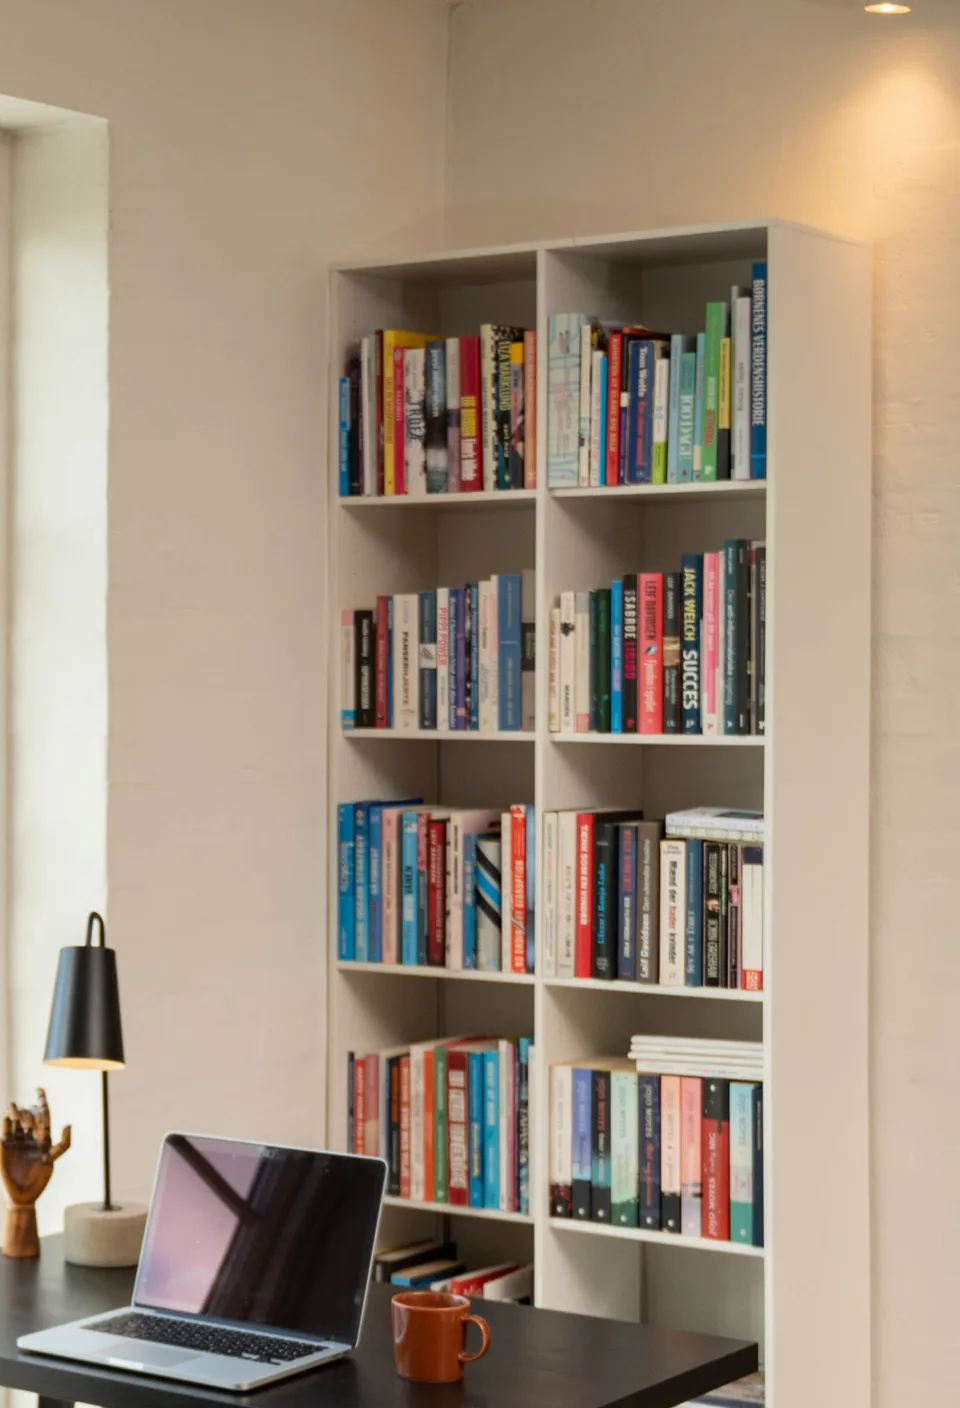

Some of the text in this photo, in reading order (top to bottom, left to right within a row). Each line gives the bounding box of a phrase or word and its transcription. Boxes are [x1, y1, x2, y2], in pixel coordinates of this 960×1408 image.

[499, 341, 511, 360] LIZA
[638, 347, 648, 398] Tom Wolfe
[752, 279, 764, 426] BØRNENES VERDENSHISTORIE
[499, 361, 511, 411] MARKLUND
[679, 394, 692, 461] 100 DAGE
[439, 607, 448, 631] PIPPI
[645, 581, 657, 640] LEIF DAVIDSEN
[683, 567, 695, 641] JACK WELCH
[624, 596, 635, 680] SABROE LIBIDO
[682, 651, 697, 710] SUCCES
[580, 853, 588, 874] SOM
[580, 875, 588, 889] EN
[580, 890, 588, 925] VINDER
[669, 861, 678, 964] Mænd der hader kvinder
[640, 913, 650, 957] Davidsen
[708, 919, 717, 978] JOHN GRISHAM
[641, 959, 650, 978] Leif
[644, 1084, 652, 1106] JOJO
[708, 1212, 717, 1236] JOJO
